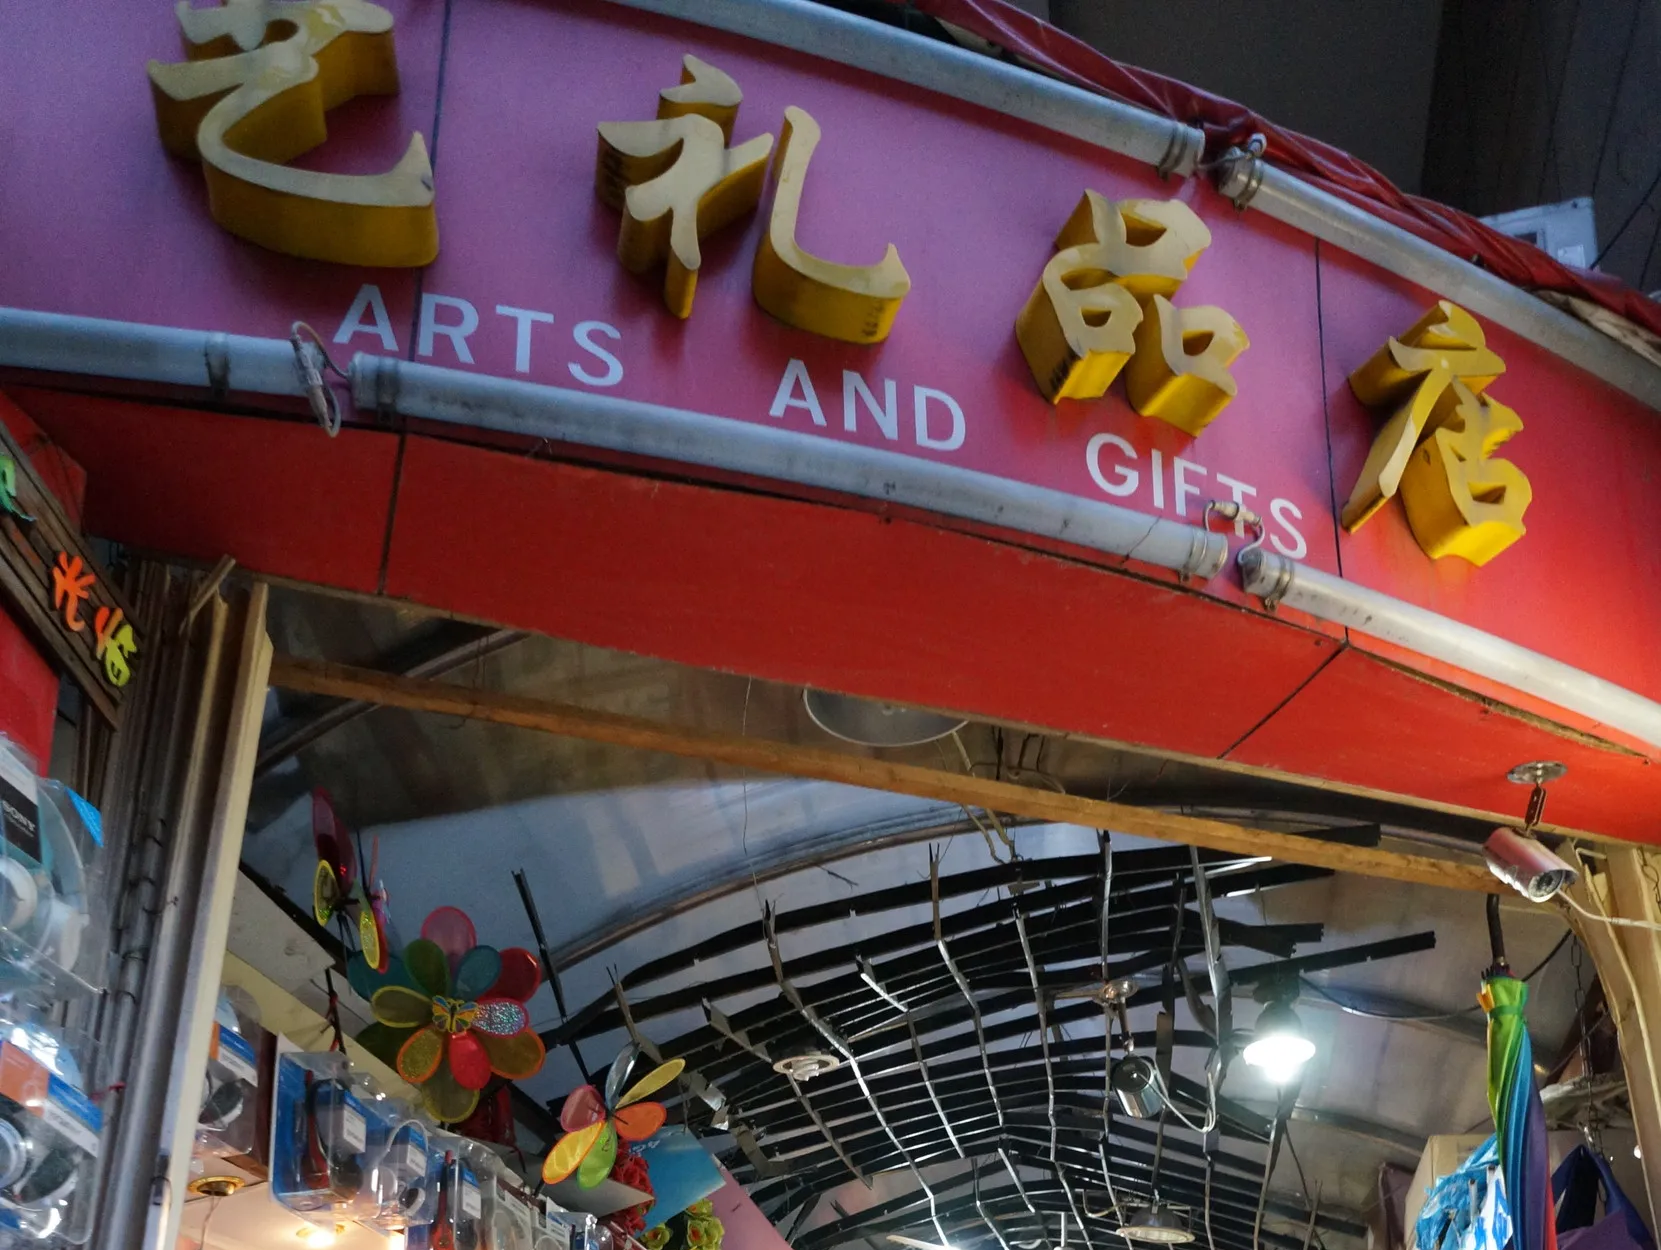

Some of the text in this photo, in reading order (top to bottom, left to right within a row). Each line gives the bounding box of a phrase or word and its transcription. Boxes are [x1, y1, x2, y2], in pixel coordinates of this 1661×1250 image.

[332, 283, 1308, 560] ARTS AND GIFTS
